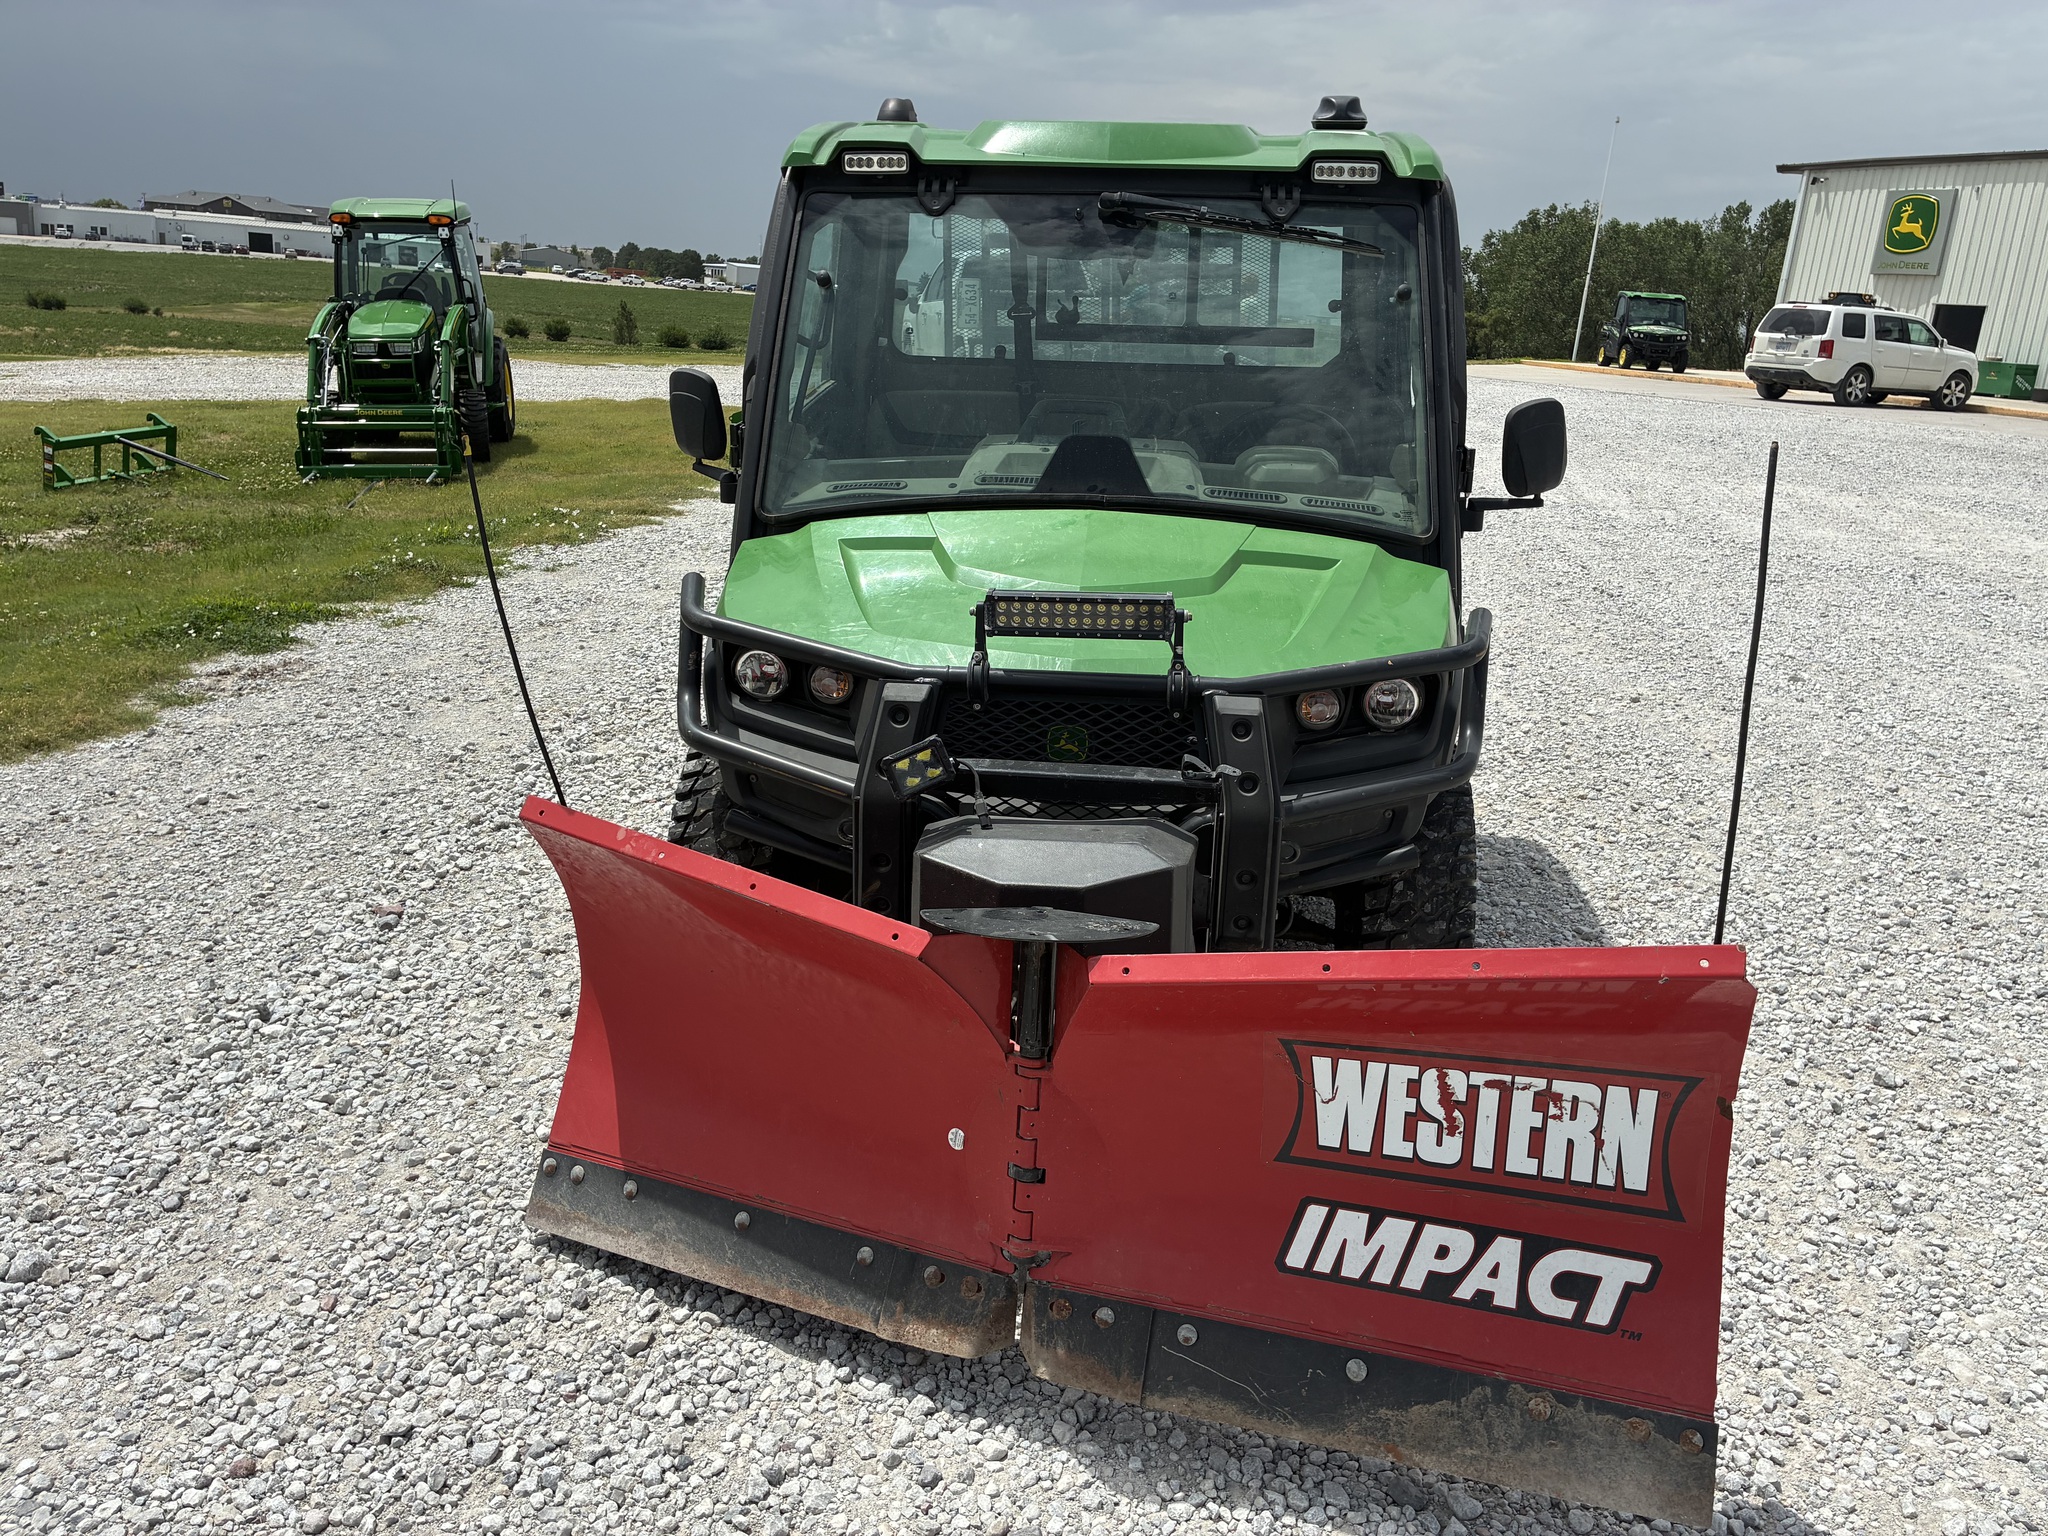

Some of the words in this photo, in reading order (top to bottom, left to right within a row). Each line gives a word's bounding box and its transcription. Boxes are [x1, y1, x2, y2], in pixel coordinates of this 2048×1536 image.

[965, 284, 977, 324] 54-X634
[1877, 261, 1898, 269] JOHN
[1899, 261, 1930, 270] DEERE
[1310, 1055, 1661, 1194] WESTERN
[1284, 1203, 1653, 1327] IMPACT
[1620, 1329, 1643, 1342] TM
